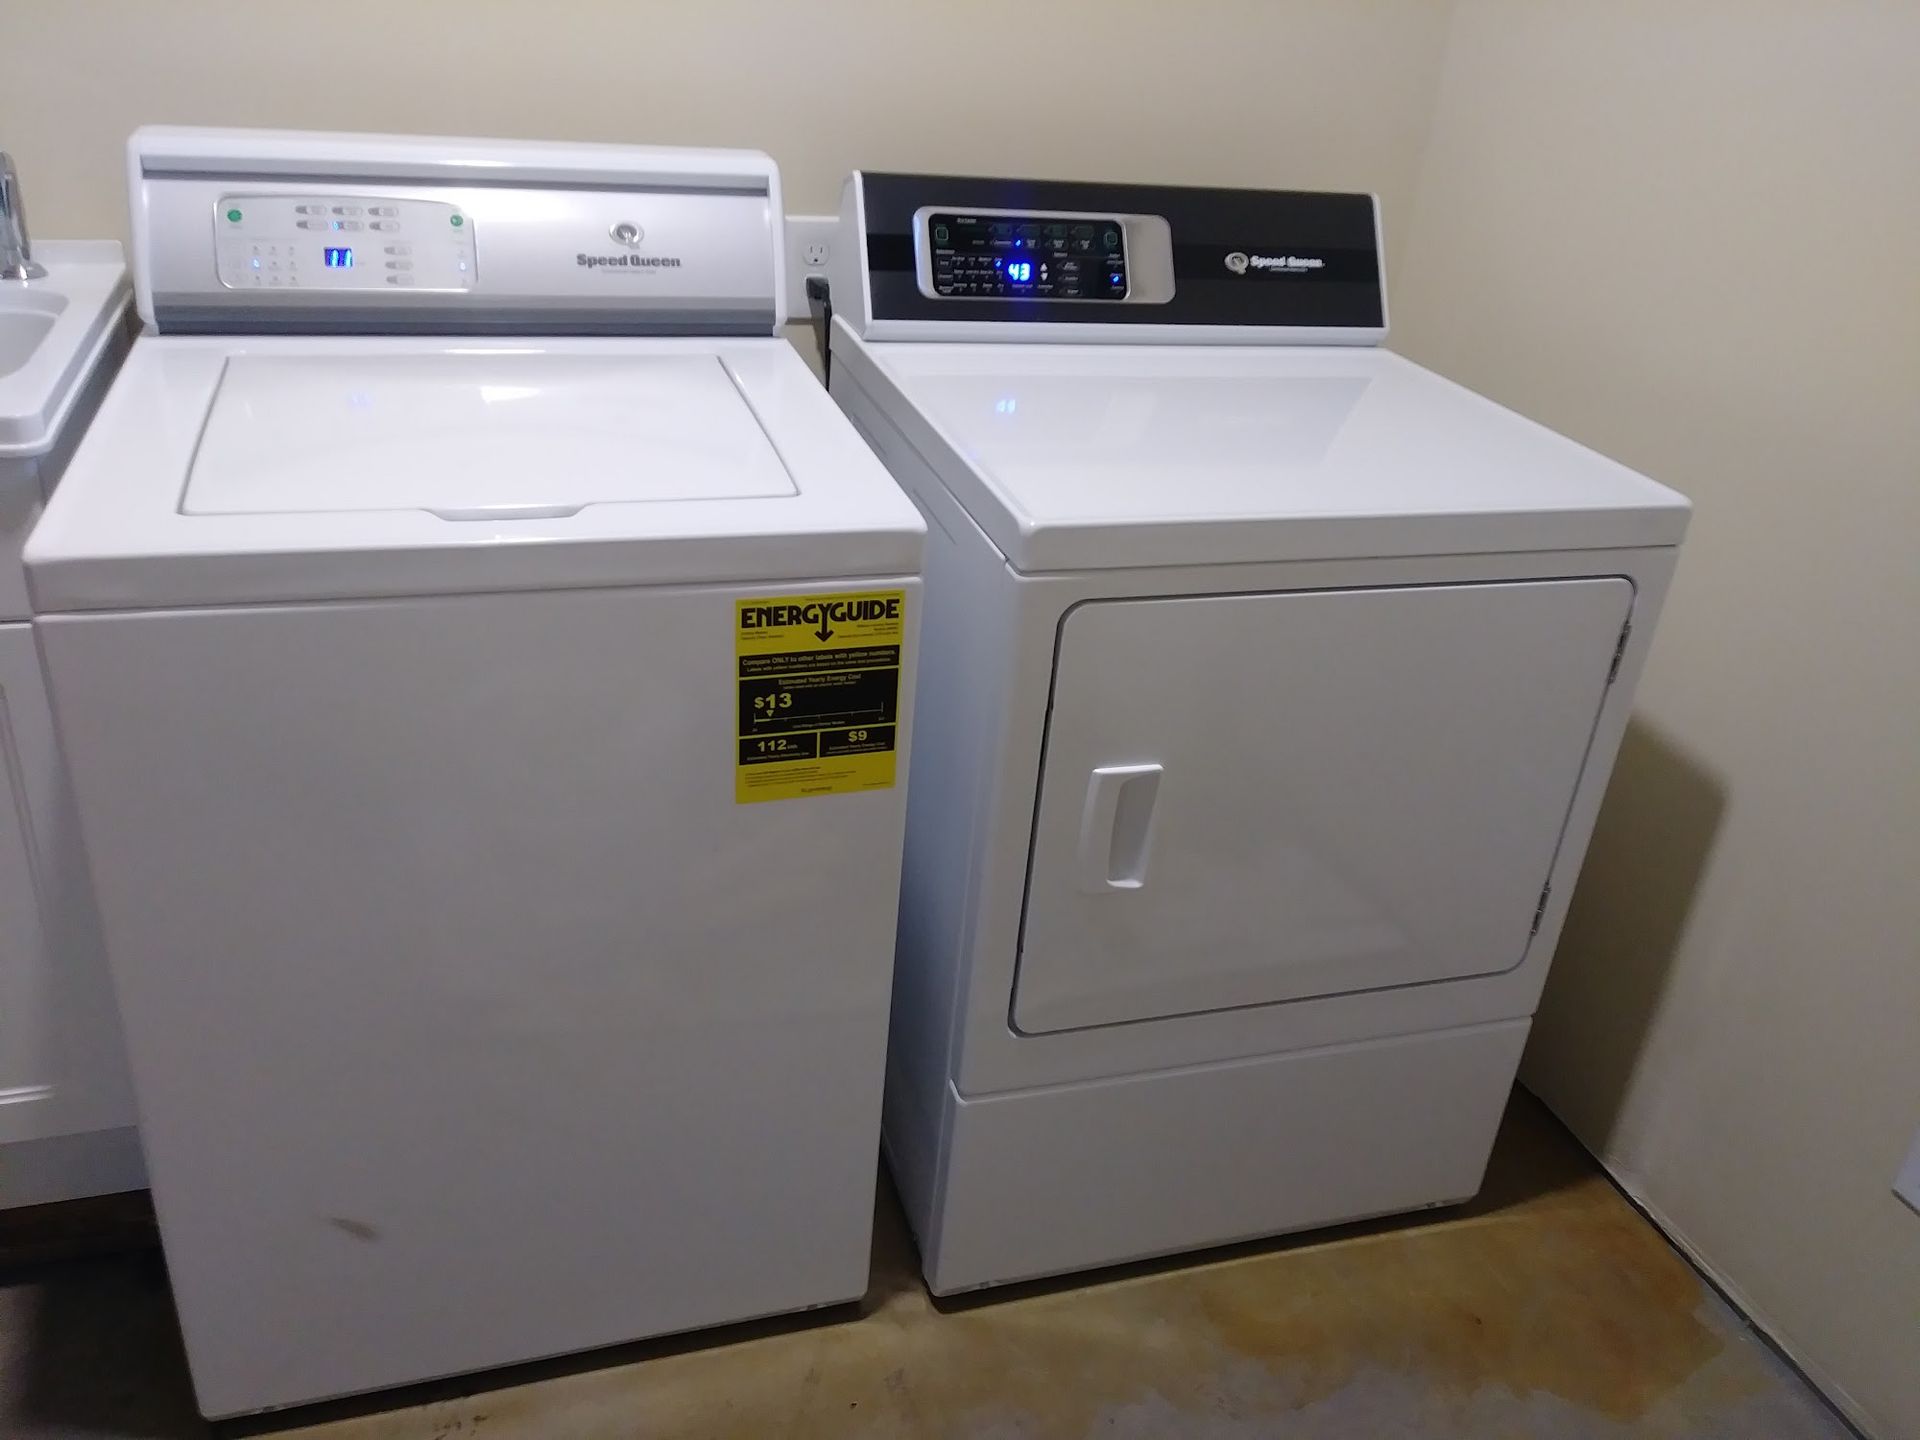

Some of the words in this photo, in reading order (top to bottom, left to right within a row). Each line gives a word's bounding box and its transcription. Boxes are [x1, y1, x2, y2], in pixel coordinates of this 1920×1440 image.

[577, 253, 628, 268] Speed
[630, 254, 681, 267] Queen
[1250, 255, 1286, 268] Speed
[1008, 262, 1031, 281] 43
[741, 599, 900, 630] ENERGYGUIDE
[742, 658, 771, 667] Compare
[772, 656, 789, 664] ONLY
[798, 654, 815, 662] other
[754, 692, 792, 709] $13
[848, 730, 868, 742] $9
[757, 739, 787, 752] 112
